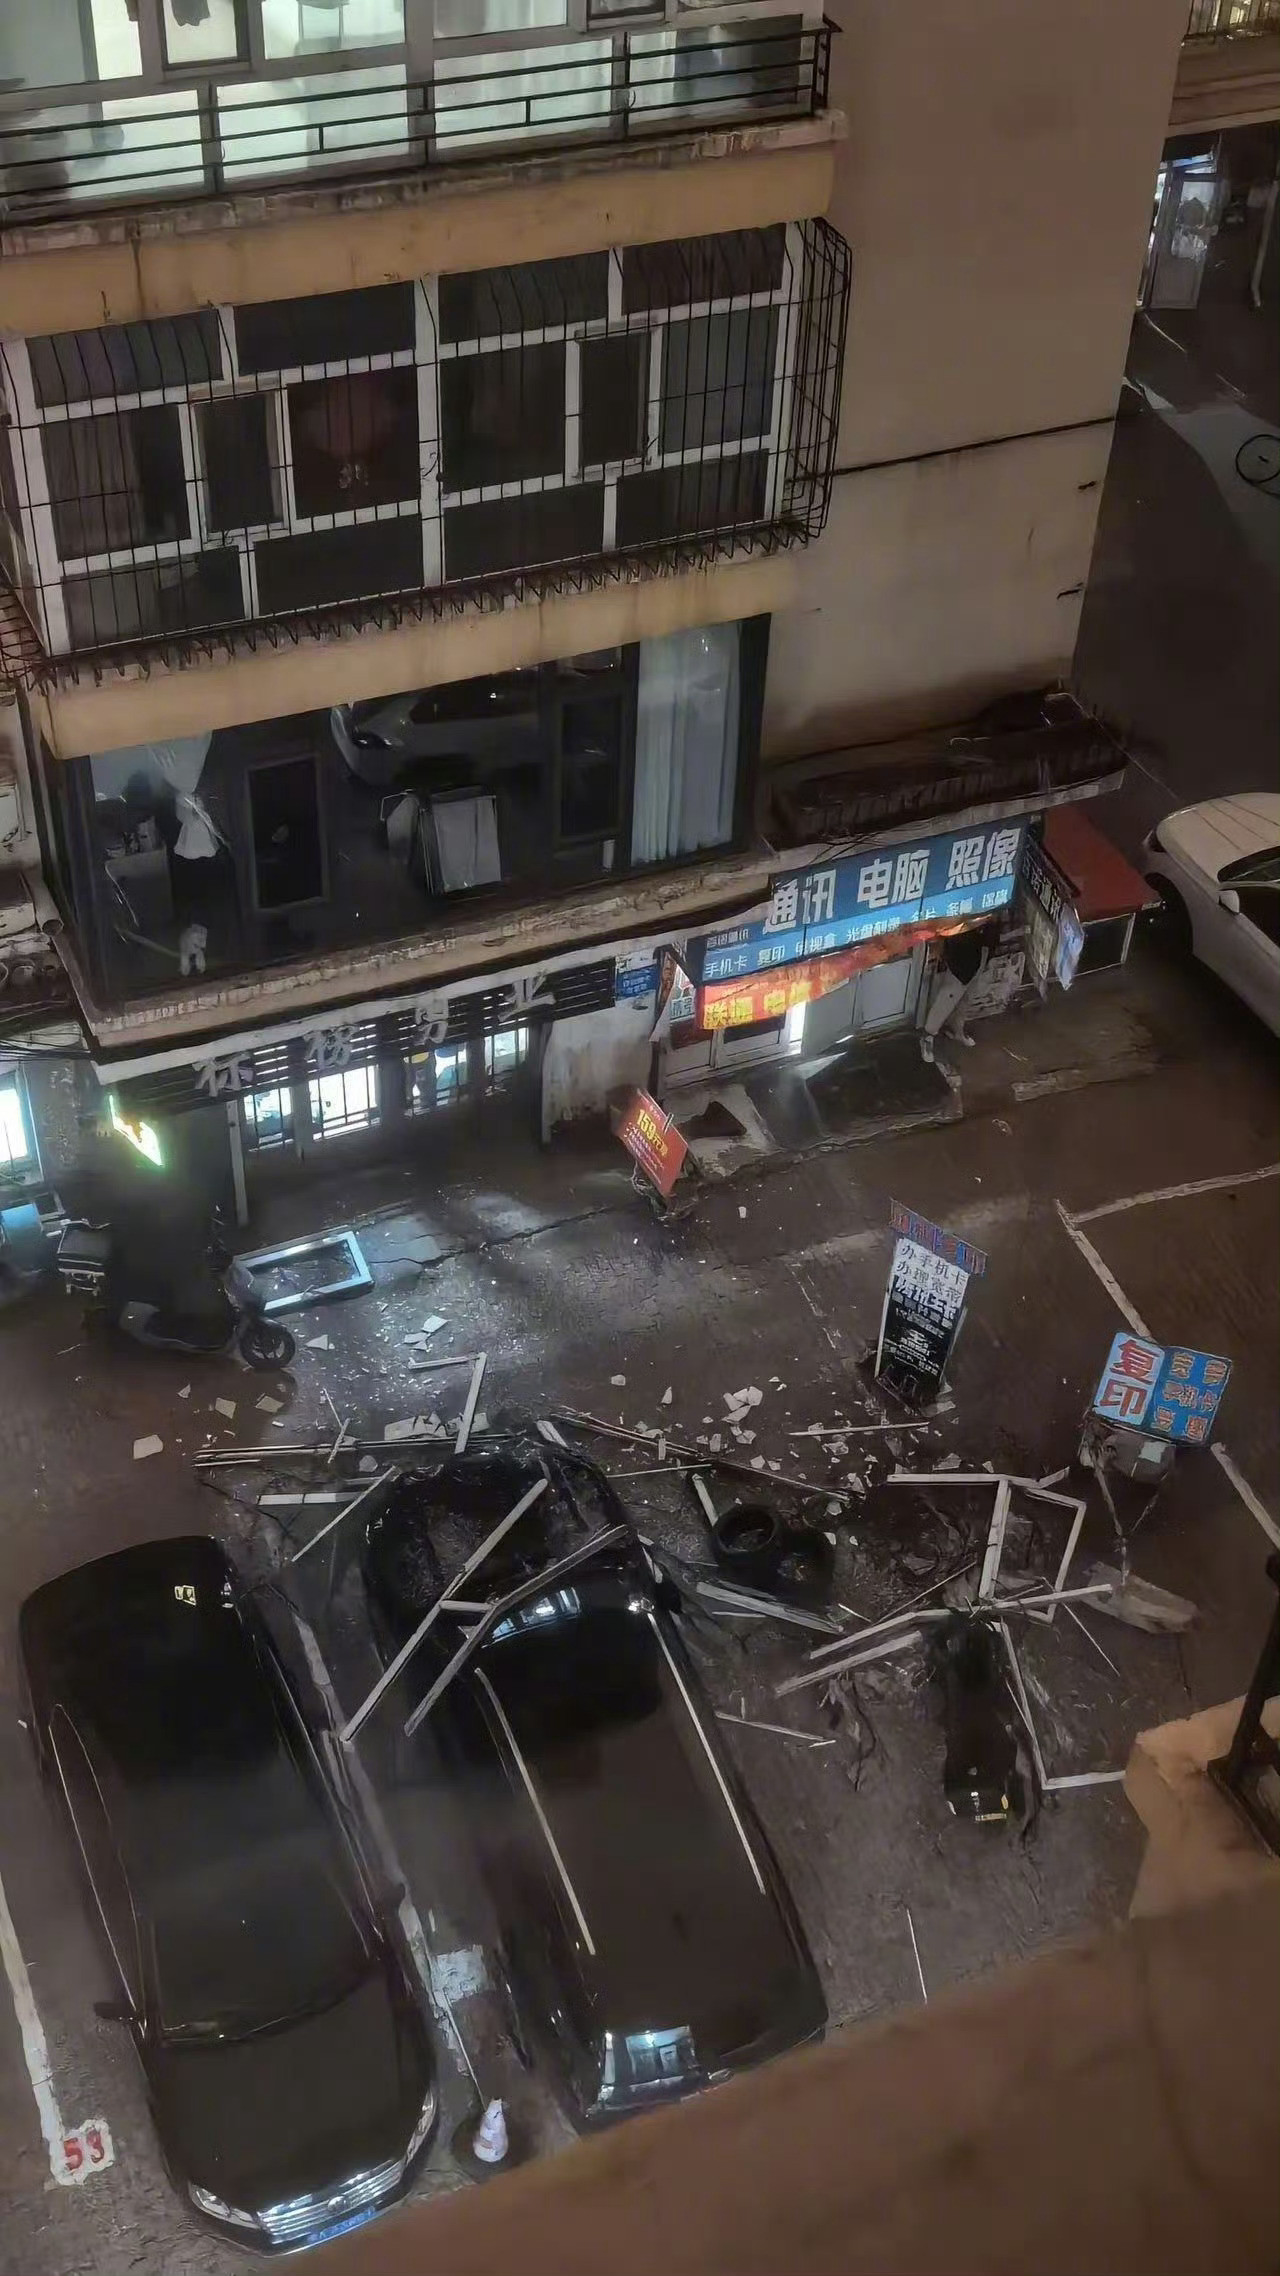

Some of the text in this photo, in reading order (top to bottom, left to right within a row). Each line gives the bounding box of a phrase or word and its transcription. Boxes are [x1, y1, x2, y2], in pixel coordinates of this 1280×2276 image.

[763, 869, 836, 934] 通讯
[857, 849, 931, 909] 电脑
[945, 827, 1021, 891] 照像
[705, 955, 748, 978] 手机卡
[901, 1244, 968, 1285] 办手机卡
[1099, 1339, 1161, 1417] 复印
